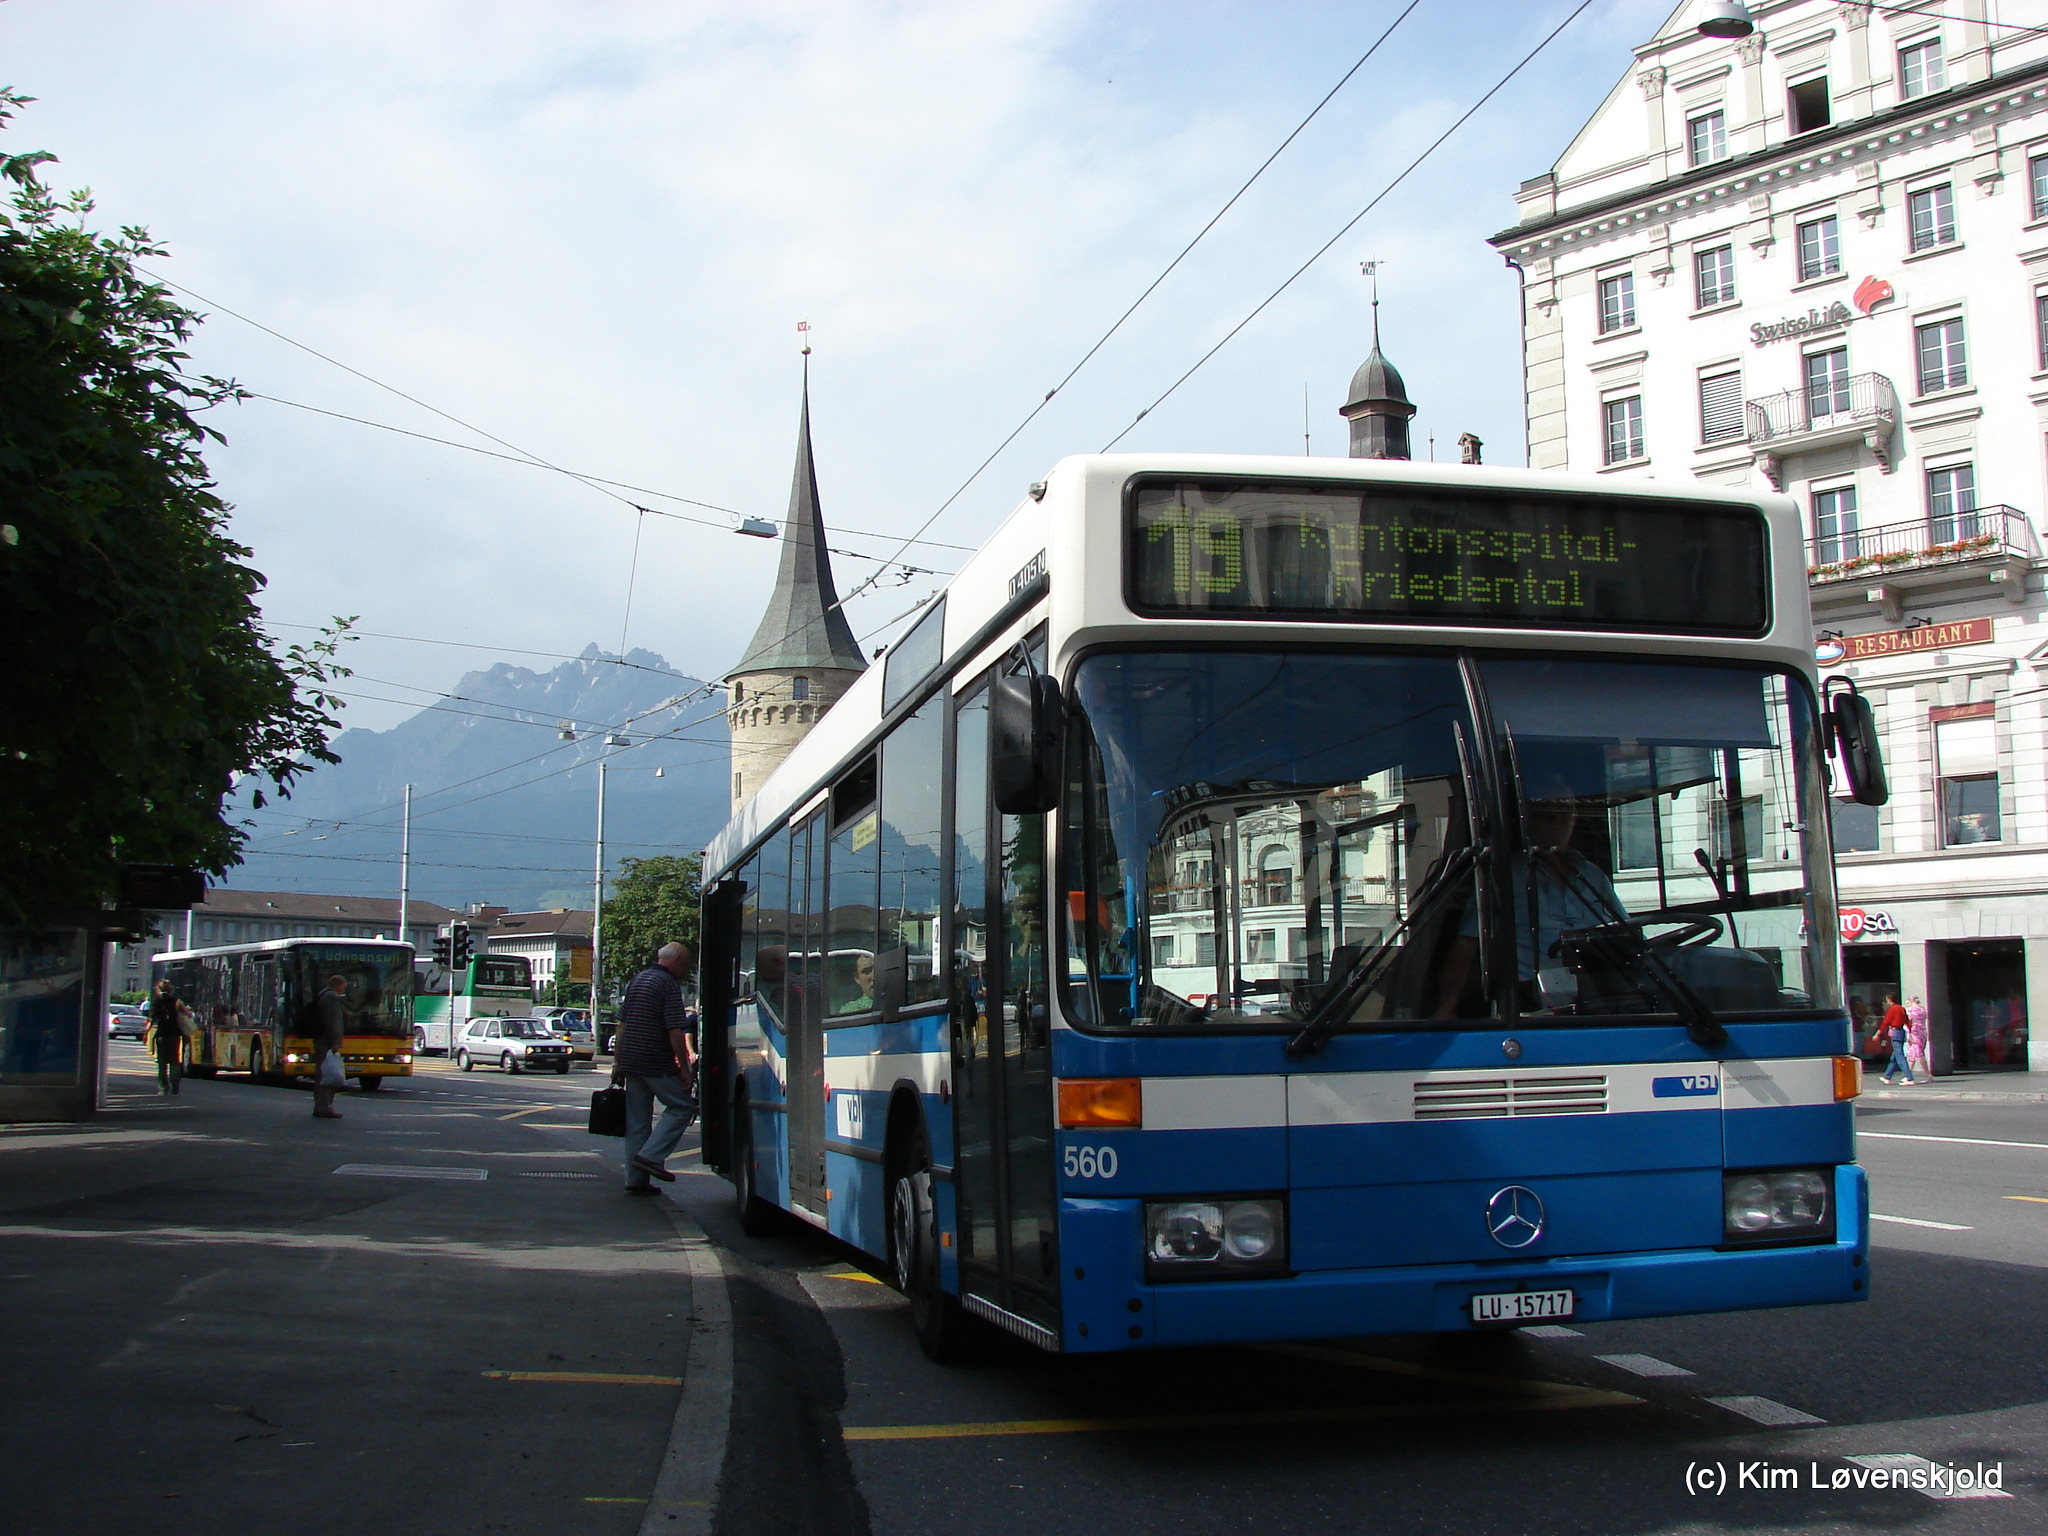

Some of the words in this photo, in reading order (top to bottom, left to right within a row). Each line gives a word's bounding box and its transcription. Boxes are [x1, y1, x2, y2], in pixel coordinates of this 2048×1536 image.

[1147, 505, 1242, 594] 19
[1300, 511, 1637, 563] Kantonsspital-
[1335, 561, 1584, 606] Friedental
[1854, 623, 1973, 656] RESTAURANT
[1681, 1075, 1717, 1090] vbl
[1064, 1145, 1118, 1179] 560
